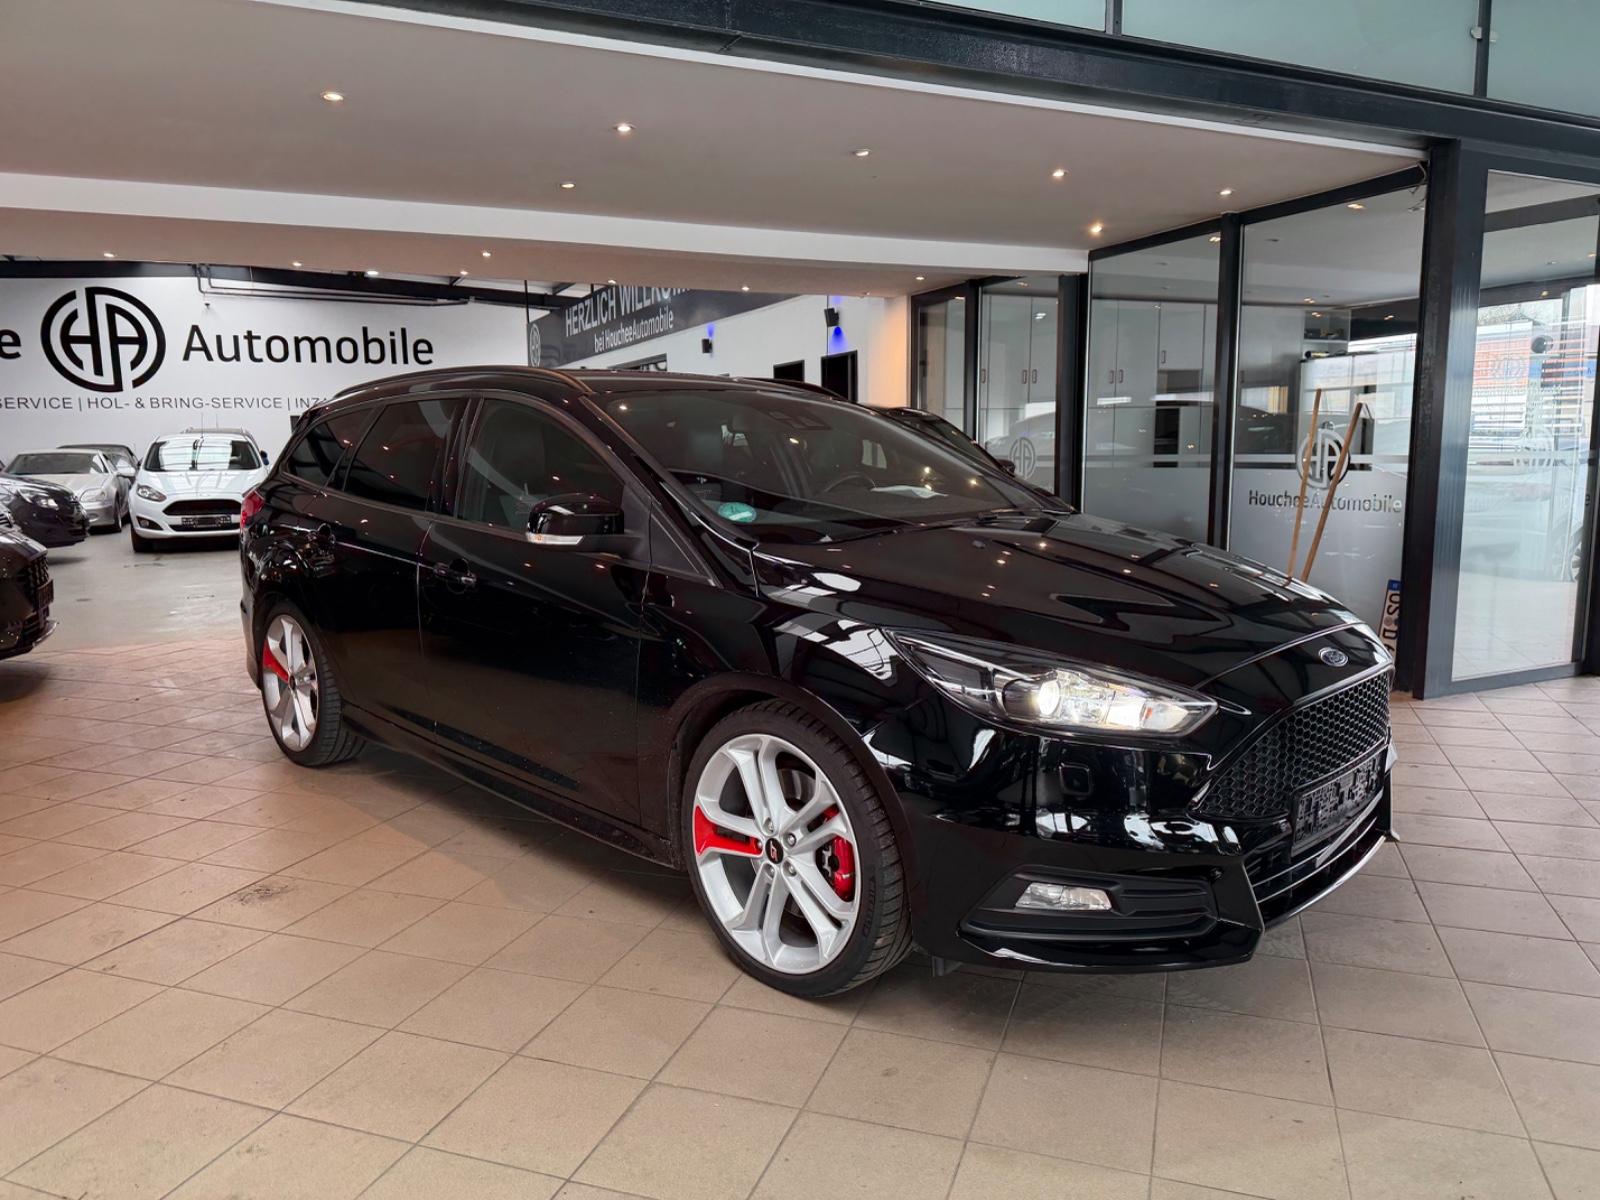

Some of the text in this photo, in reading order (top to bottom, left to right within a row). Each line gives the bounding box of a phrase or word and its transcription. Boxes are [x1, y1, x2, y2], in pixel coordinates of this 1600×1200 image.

[565, 287, 617, 337] HERZLICH
[182, 324, 433, 365] Automobile
[594, 333, 604, 353] bei
[0, 397, 73, 409] ERVICE
[87, 397, 130, 409] HOL-
[135, 397, 145, 409] &
[150, 397, 282, 409] BRING-SERVICE
